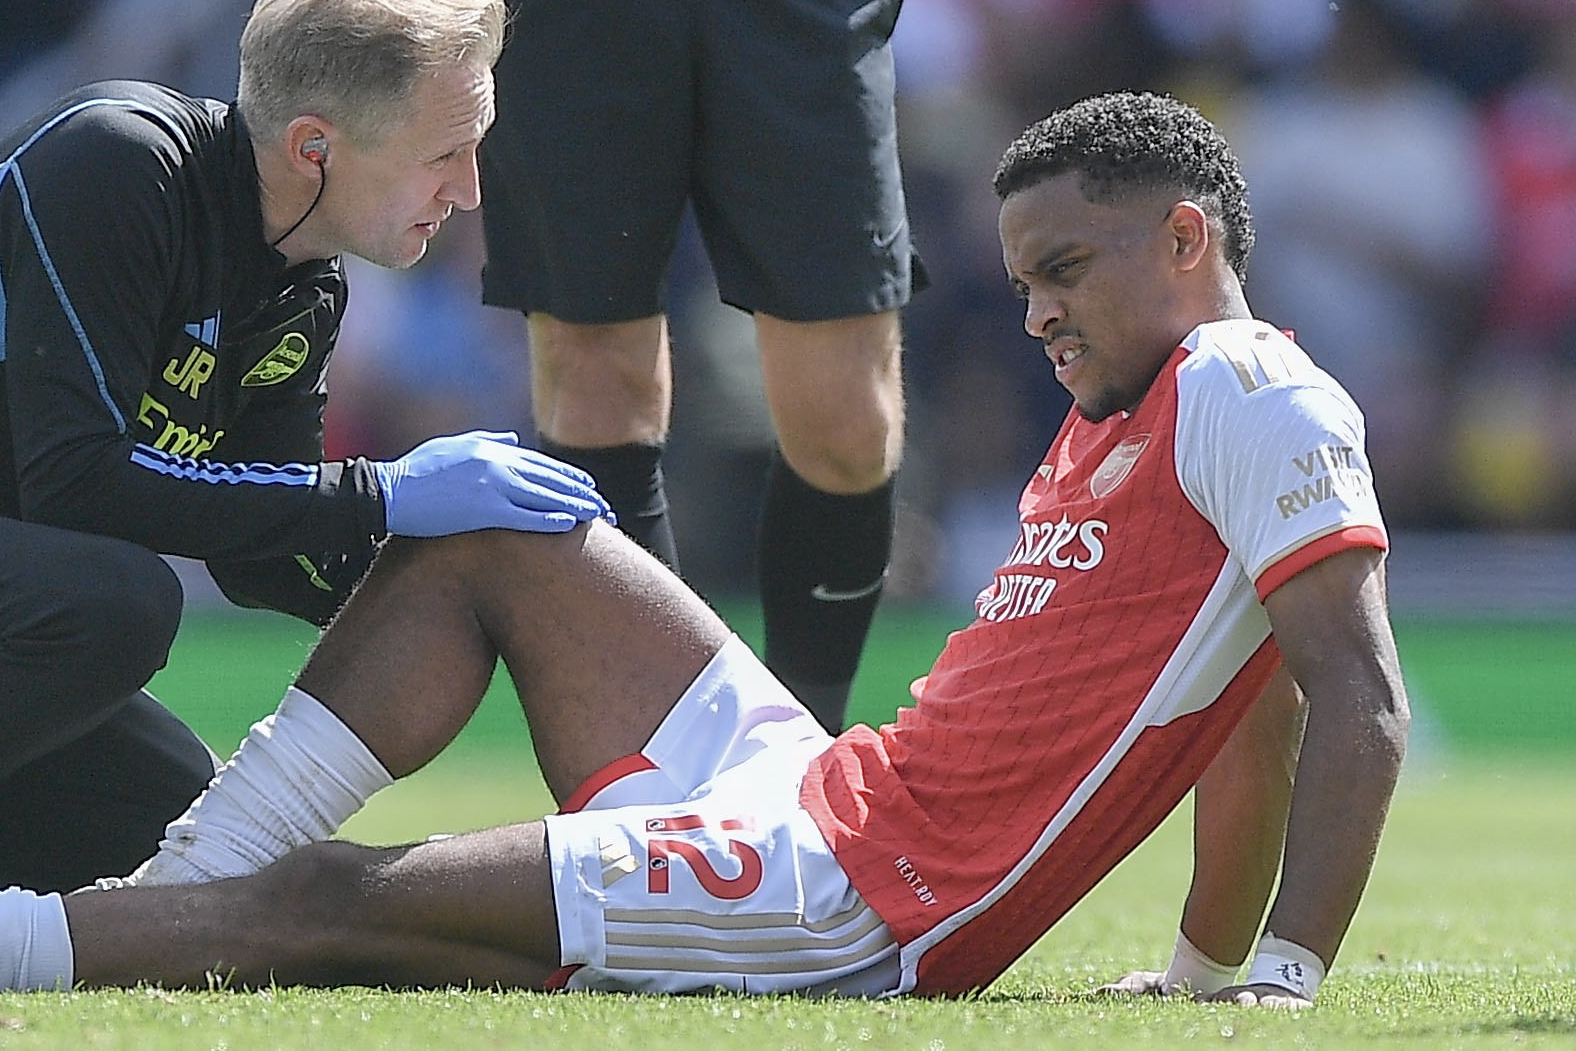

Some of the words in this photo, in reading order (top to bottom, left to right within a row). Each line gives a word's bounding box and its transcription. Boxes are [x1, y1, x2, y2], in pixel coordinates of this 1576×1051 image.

[162, 346, 216, 400] JR
[645, 814, 764, 901] 12
[894, 856, 938, 906] HEAT.RDY
